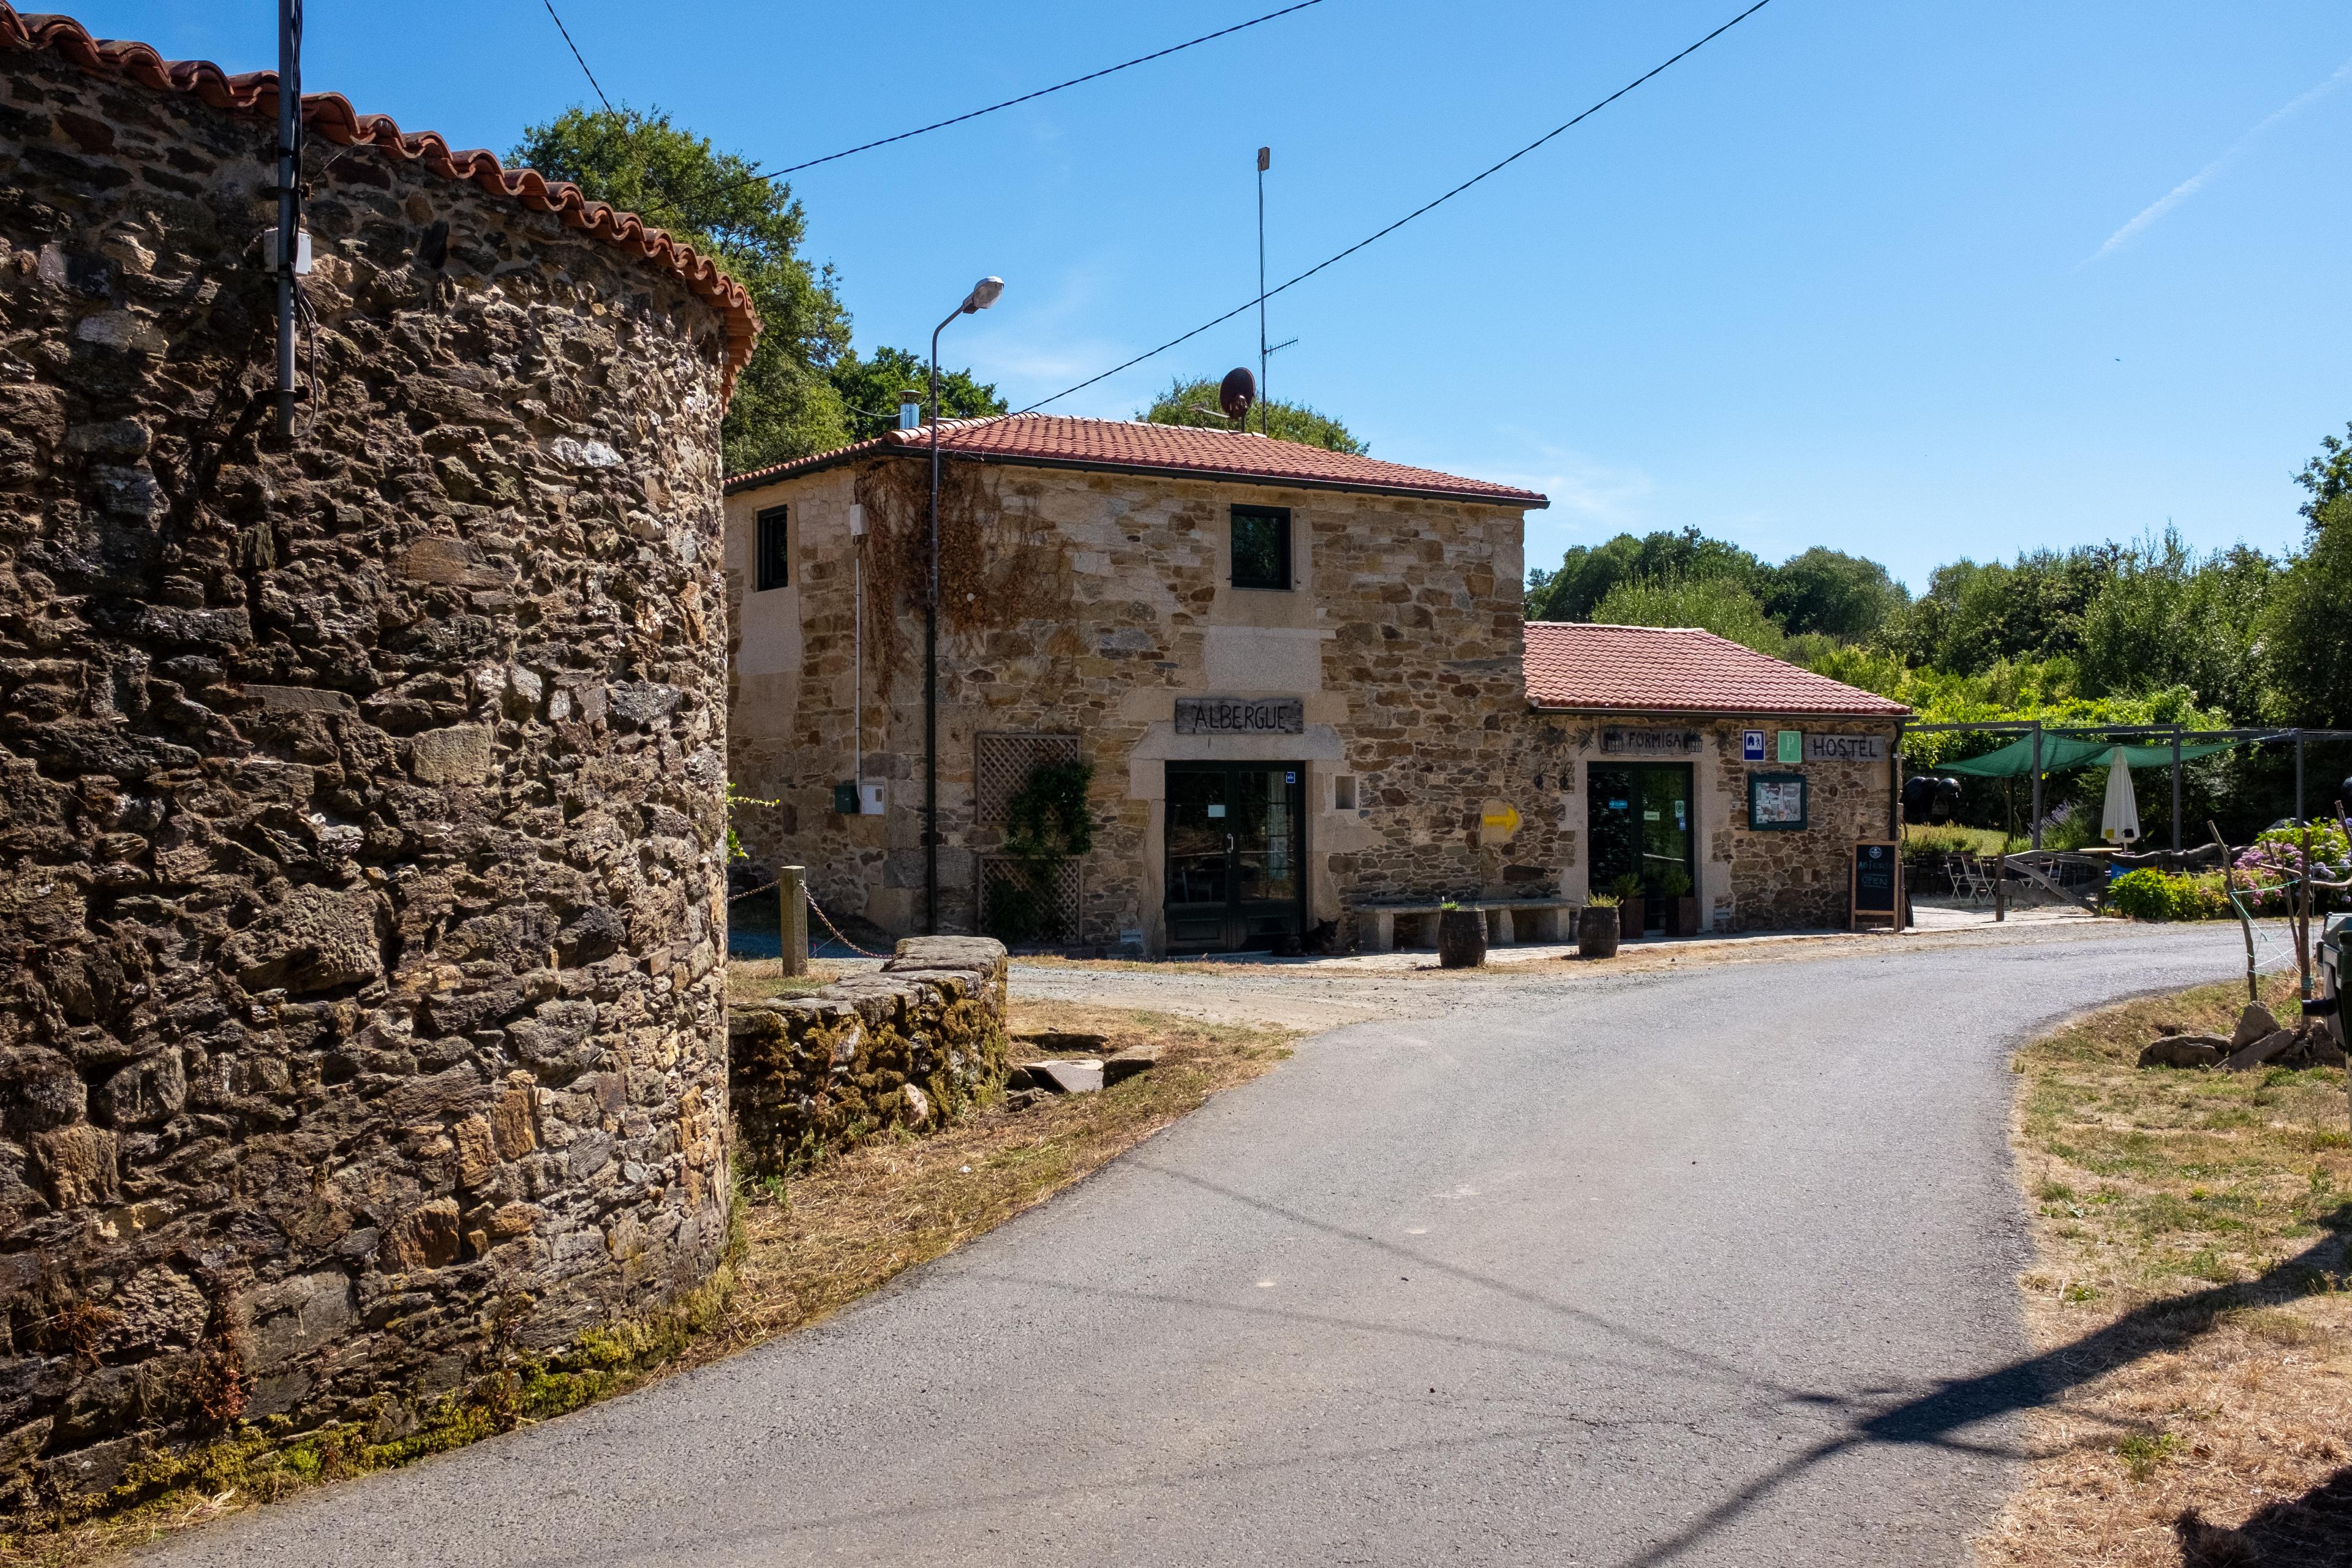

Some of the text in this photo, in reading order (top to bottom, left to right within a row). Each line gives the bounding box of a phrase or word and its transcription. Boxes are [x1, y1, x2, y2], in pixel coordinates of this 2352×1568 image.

[1194, 704, 1287, 729] ALBERGUE
[1629, 731, 1681, 748] FORMIGA
[1813, 737, 1879, 758] HOSTEL
[1861, 876, 1888, 886] OPEN
